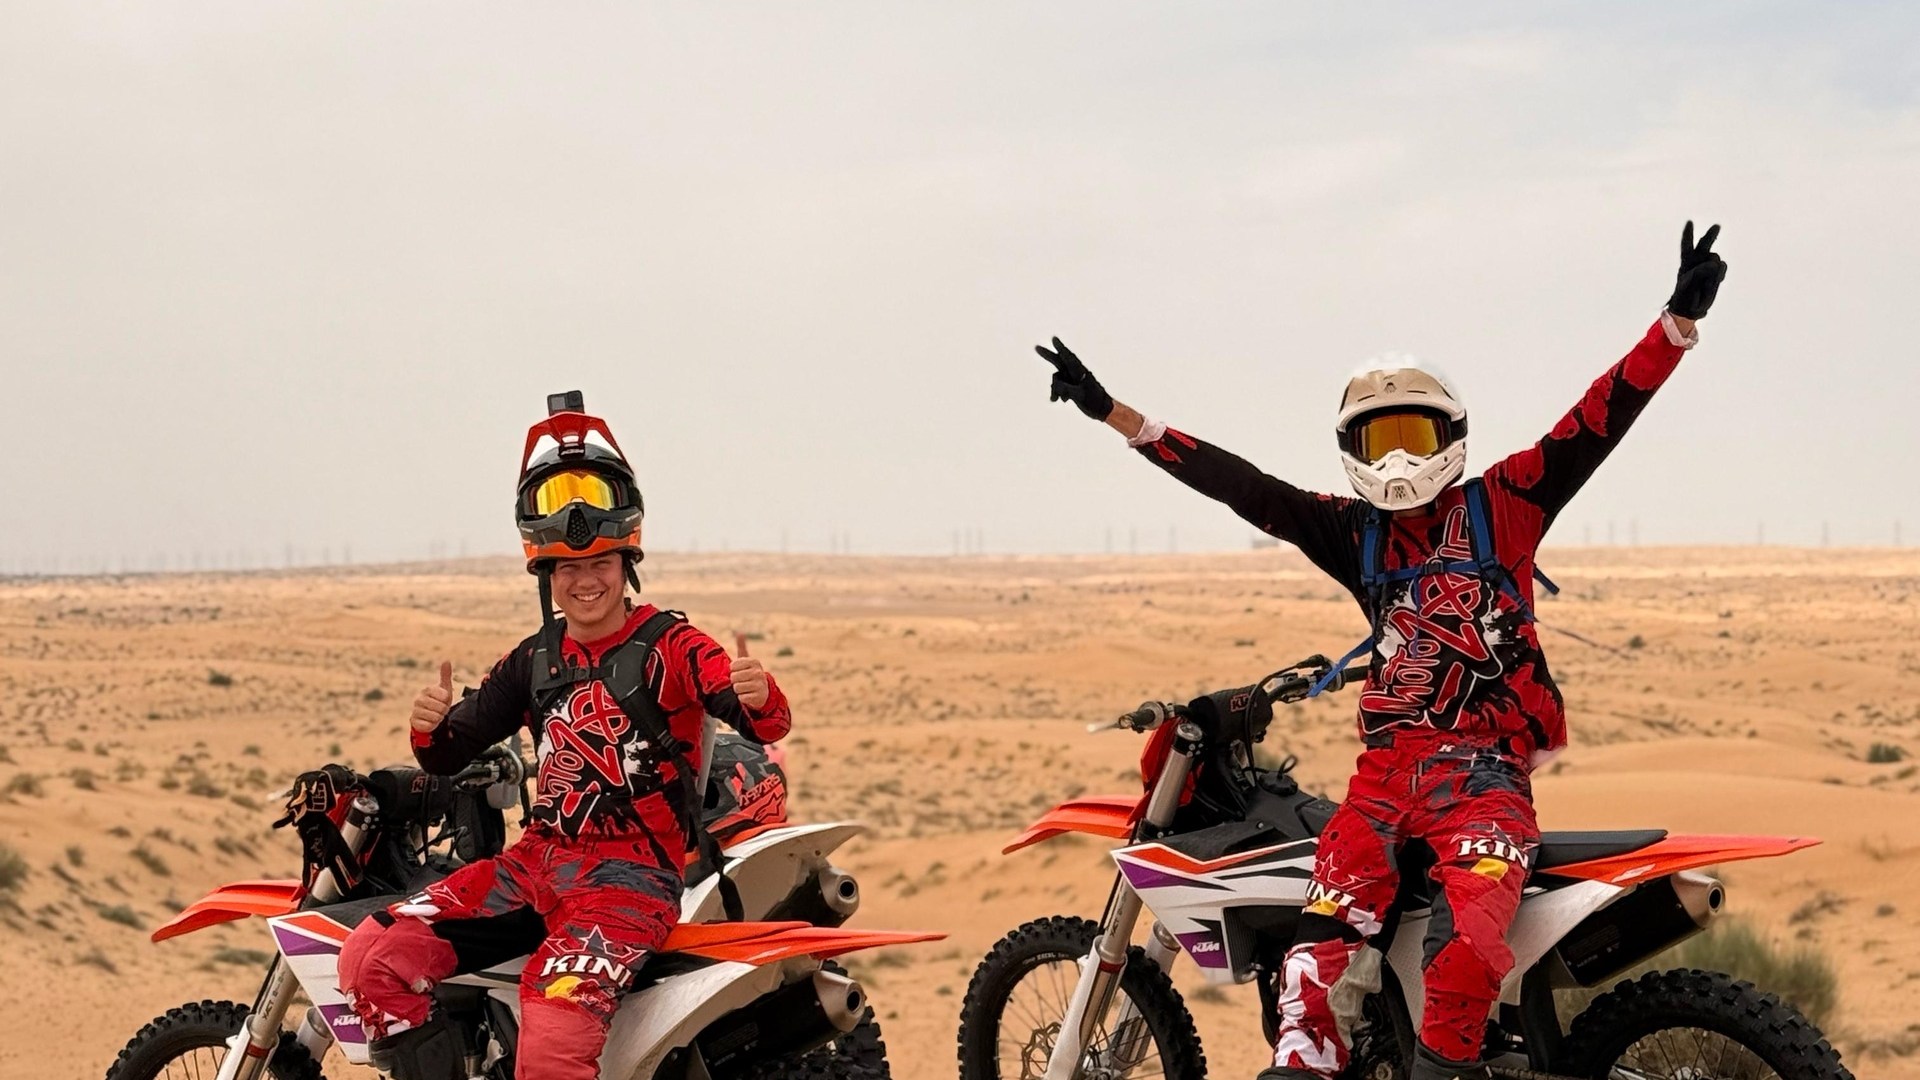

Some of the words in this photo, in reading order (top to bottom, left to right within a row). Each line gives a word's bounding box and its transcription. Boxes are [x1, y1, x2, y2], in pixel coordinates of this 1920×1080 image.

[1230, 693, 1256, 713] KT
[1458, 838, 1529, 870] KIN
[1306, 880, 1357, 907] INI
[1192, 941, 1220, 953] KTM
[333, 1015, 361, 1026] KTM
